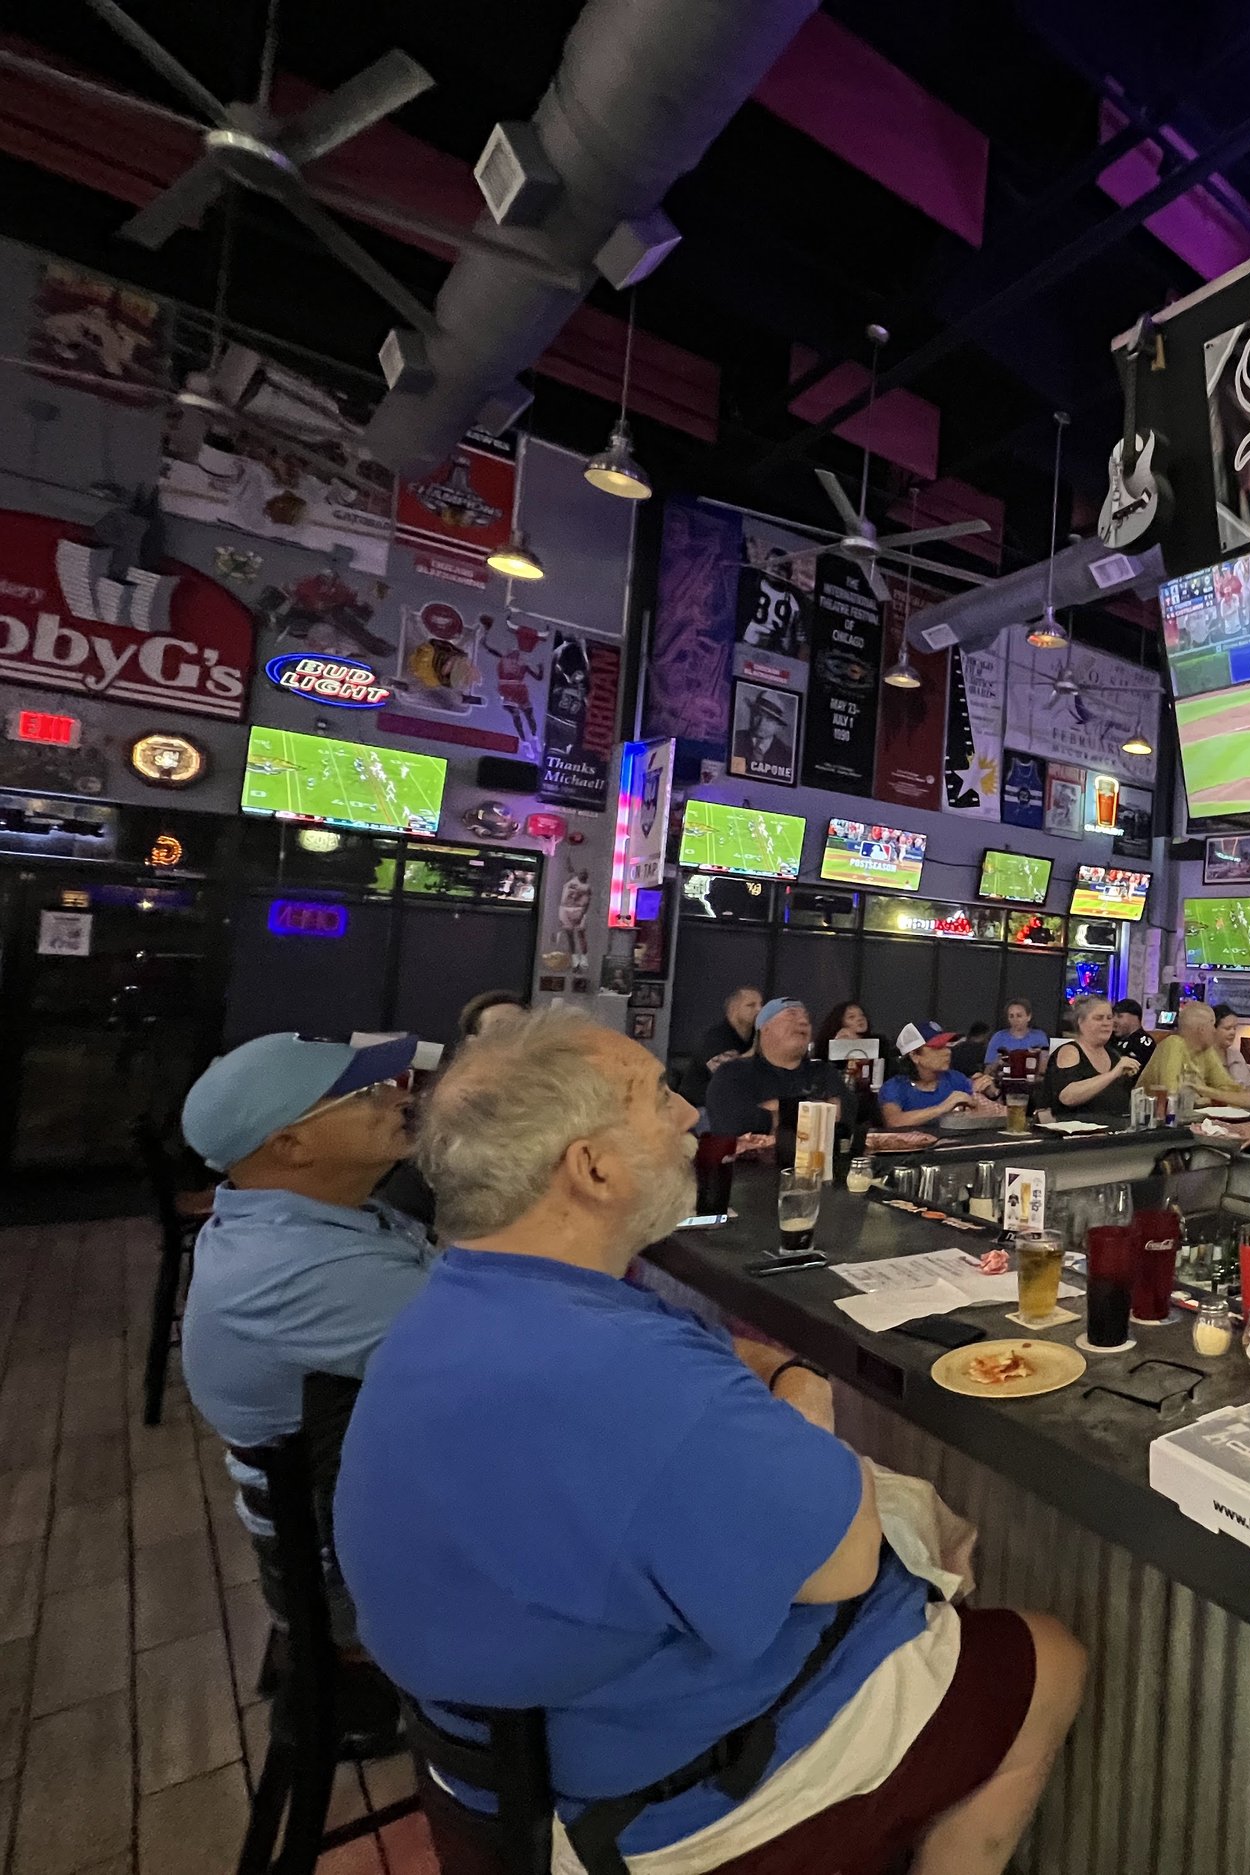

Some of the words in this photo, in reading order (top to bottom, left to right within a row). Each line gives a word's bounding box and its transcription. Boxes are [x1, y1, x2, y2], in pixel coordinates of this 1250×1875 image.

[752, 590, 793, 629] 89
[832, 629, 865, 649] CHICAGO
[296, 659, 376, 685] BUD
[280, 671, 390, 704] LIGHT
[545, 755, 597, 774] Thanks
[750, 760, 793, 778] CAPONE
[643, 861, 660, 880] TAP
[849, 858, 897, 873] POSTSEASON
